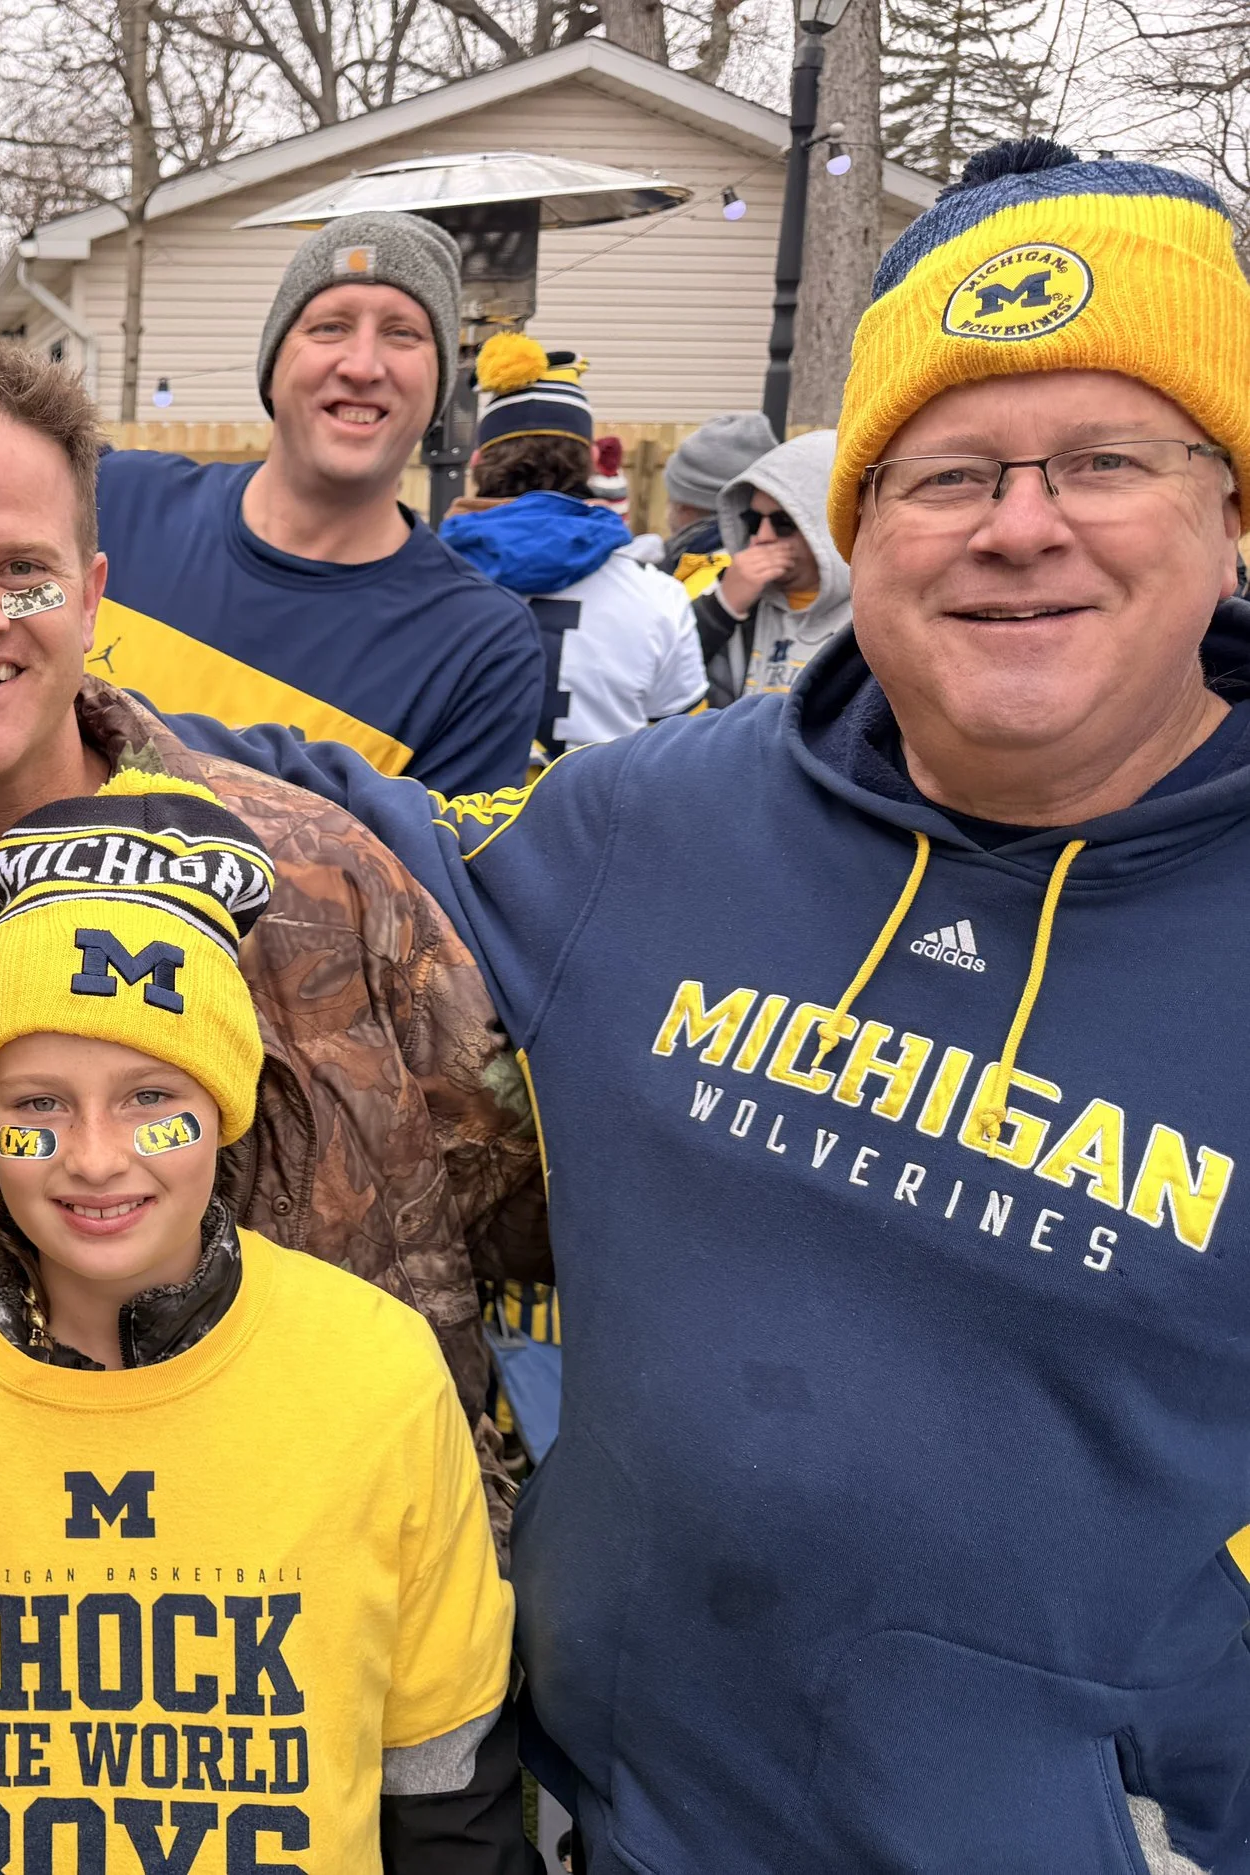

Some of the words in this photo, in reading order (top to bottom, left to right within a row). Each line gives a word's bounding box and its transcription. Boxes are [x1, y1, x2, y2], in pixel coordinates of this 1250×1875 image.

[963, 251, 1065, 293] MICHIGAN
[975, 270, 1051, 318] M
[956, 302, 1072, 336] WOLVERINES
[16, 587, 48, 611] M
[70, 928, 184, 1014] M
[910, 940, 986, 972] adidas
[150, 1116, 189, 1149] M
[652, 980, 1234, 1253] MICHIGAN
[7, 1128, 41, 1155] M
[689, 1081, 1118, 1272] WOLVERINES
[64, 1471, 156, 1539] M
[106, 1567, 302, 1583] BASKETBALL
[70, 1721, 309, 1794] WORLD
